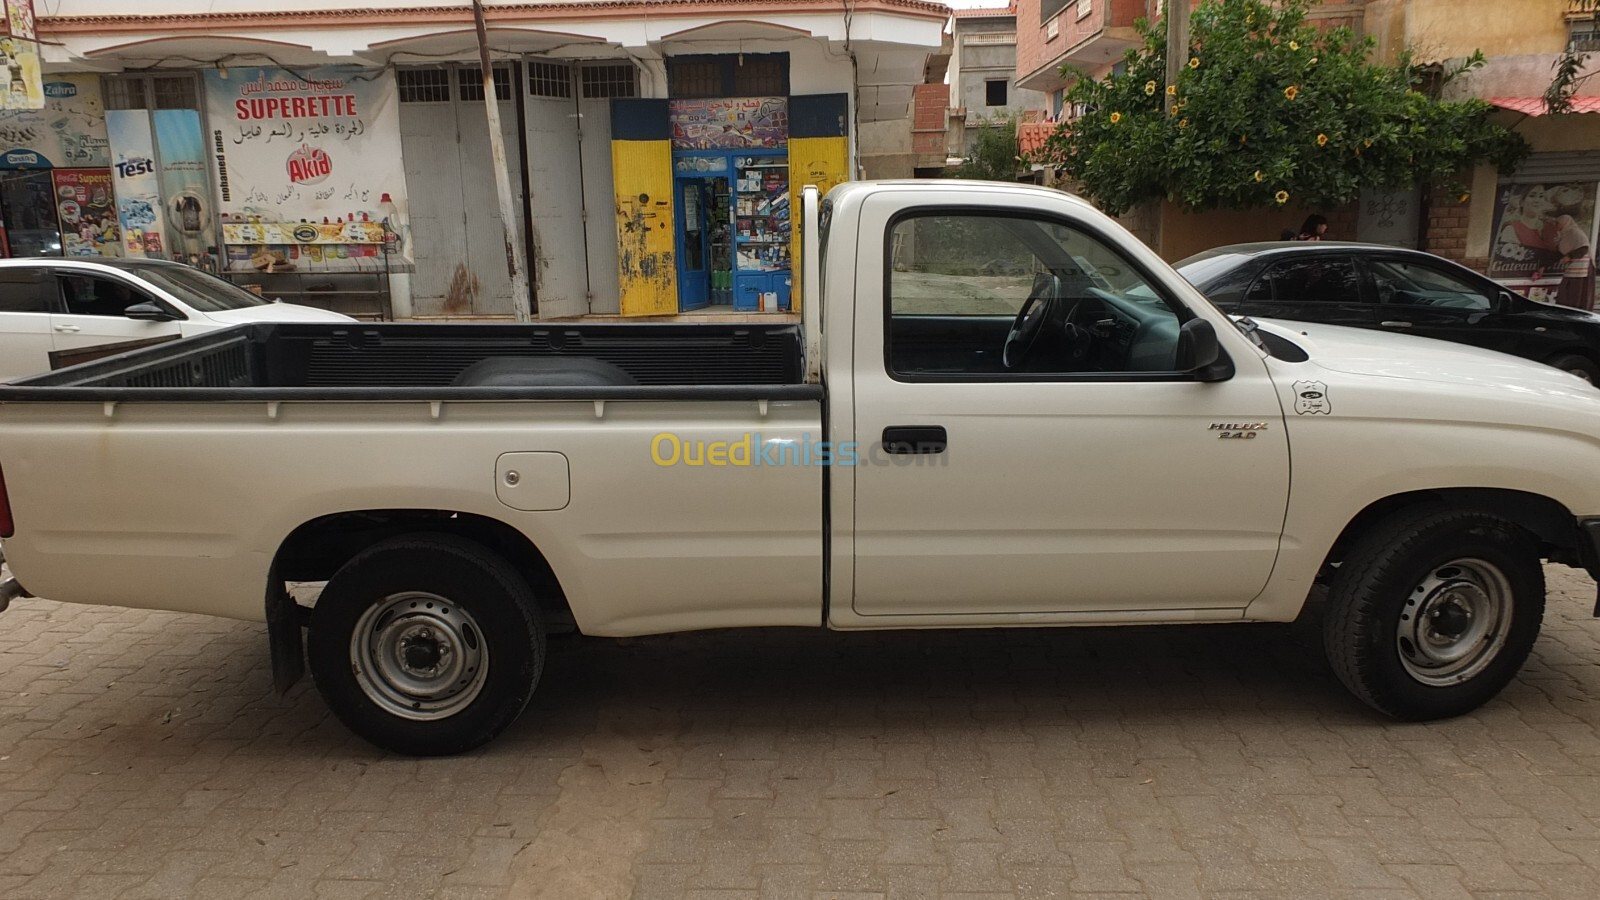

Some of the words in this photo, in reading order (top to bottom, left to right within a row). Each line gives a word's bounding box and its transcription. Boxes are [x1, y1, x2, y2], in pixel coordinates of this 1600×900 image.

[45, 85, 76, 95] Zahra
[267, 79, 297, 92] محمد
[235, 94, 357, 120] SUPERETTE
[265, 121, 293, 144] السعر
[296, 131, 304, 142] و
[308, 122, 329, 139] عالية
[334, 119, 365, 141] الجودة
[214, 129, 224, 153] anes
[115, 158, 154, 179] Test
[289, 149, 330, 183] Akid
[215, 154, 231, 202] mohamed
[1207, 422, 1268, 431] HILUX
